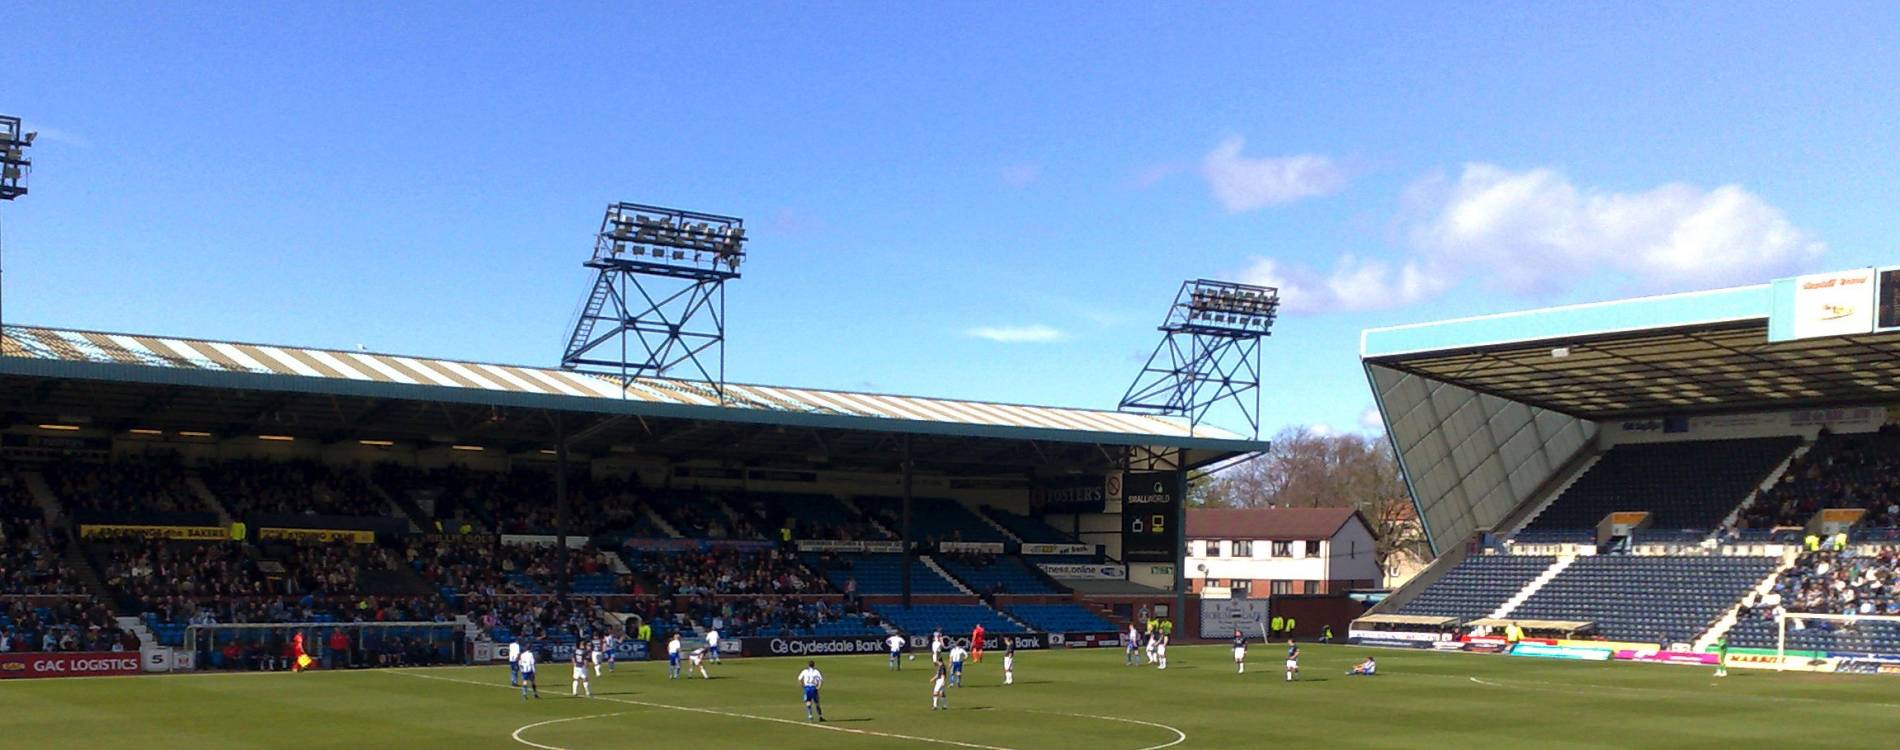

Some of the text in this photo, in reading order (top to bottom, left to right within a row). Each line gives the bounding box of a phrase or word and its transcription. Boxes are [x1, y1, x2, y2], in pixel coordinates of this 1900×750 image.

[188, 528, 225, 539] BAKERS
[789, 640, 854, 655] Clydesdale
[856, 639, 883, 651] Bank
[1015, 637, 1040, 649] Bank
[33, 659, 65, 672] GAC
[70, 658, 138, 672] LOGISTICS
[151, 654, 164, 664] 5
